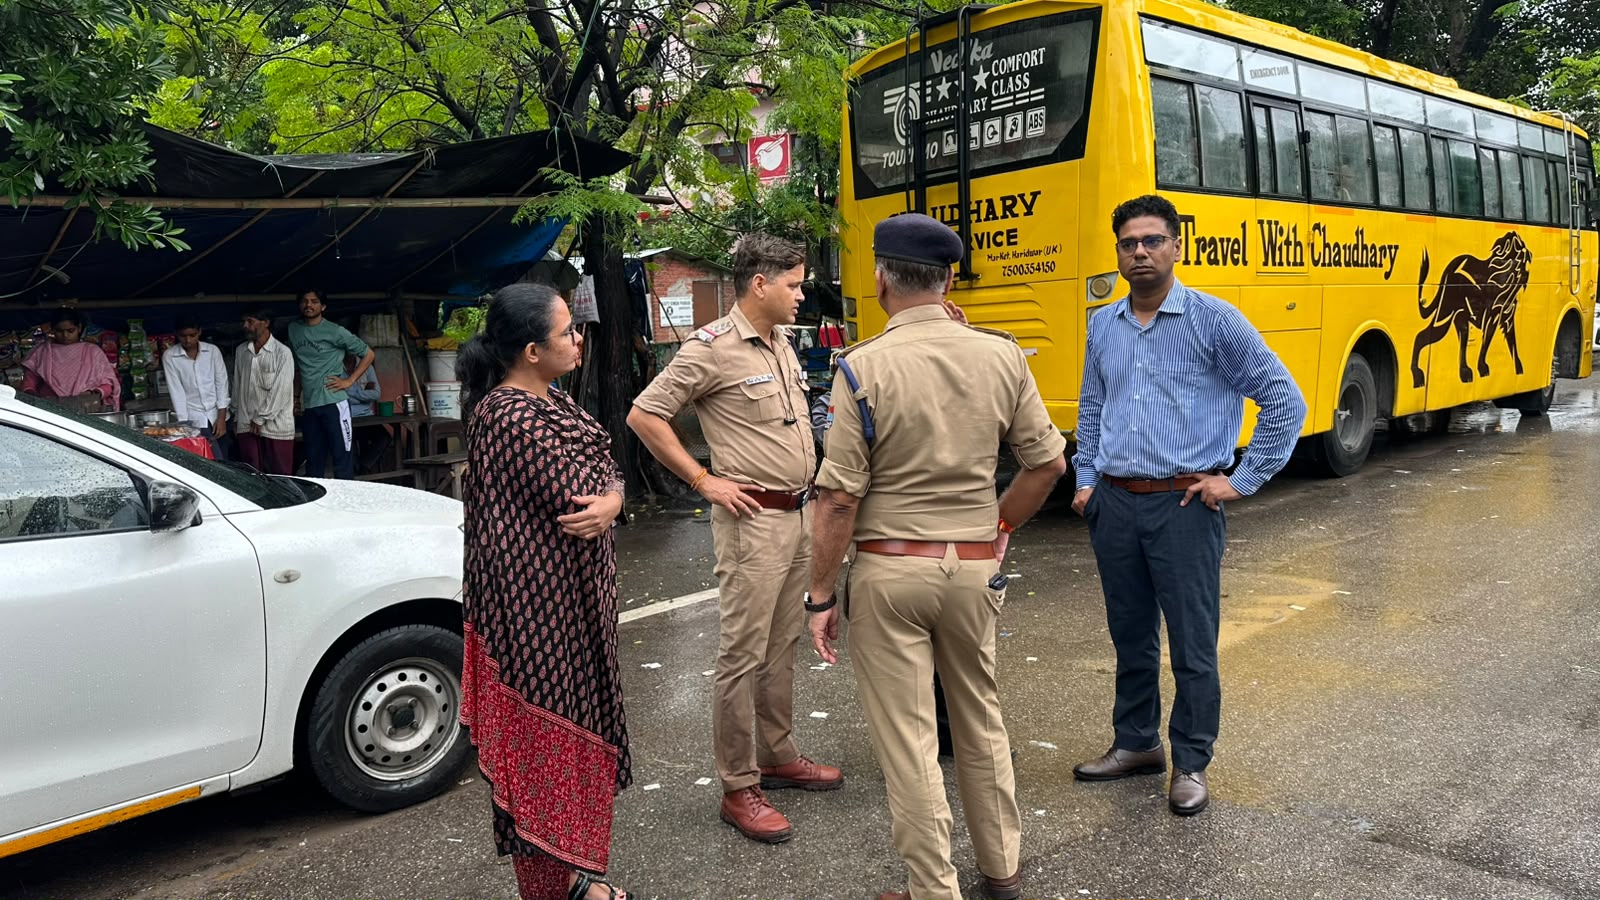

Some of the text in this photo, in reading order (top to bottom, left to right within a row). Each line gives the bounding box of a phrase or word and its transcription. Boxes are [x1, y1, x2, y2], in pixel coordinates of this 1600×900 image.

[929, 38, 994, 74] Vedka
[991, 47, 1046, 77] COMFORT
[991, 72, 1030, 97] CLASS
[1029, 112, 1044, 130] ABS
[889, 190, 1041, 228] UDHARY
[1011, 248, 1043, 259] Haridwar
[1178, 214, 1400, 281] Travel With Chaudhary
[1001, 260, 1056, 277] 7500354150
